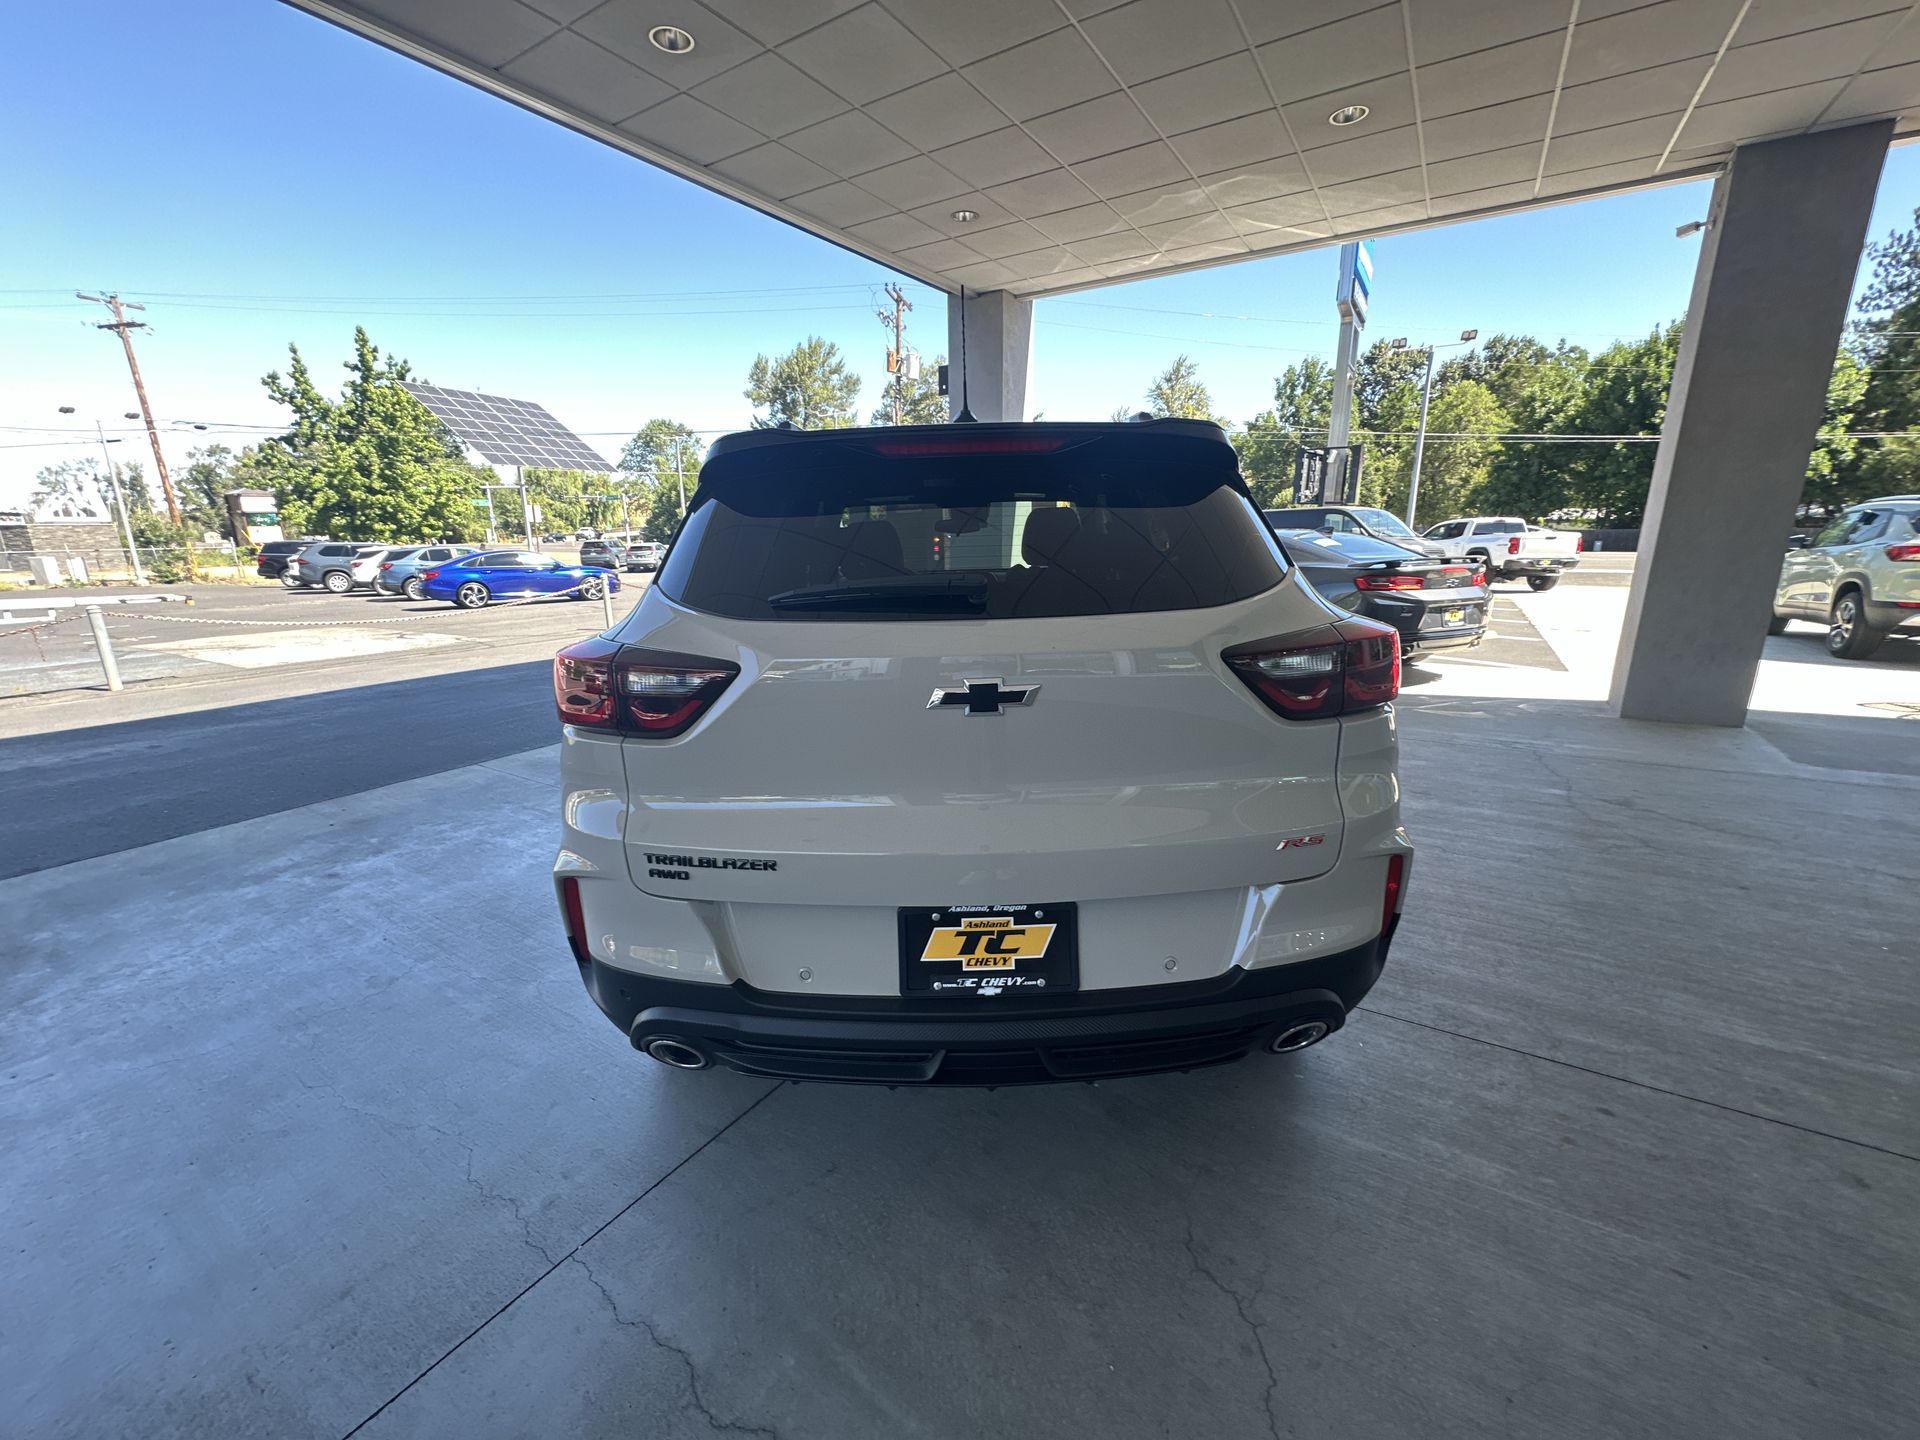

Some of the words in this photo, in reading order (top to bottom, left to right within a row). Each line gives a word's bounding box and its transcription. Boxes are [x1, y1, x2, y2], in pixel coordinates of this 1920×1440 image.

[1276, 834, 1325, 851] RS
[642, 852, 778, 872] TRAILBLAZER
[648, 868, 690, 881] AWD
[948, 905, 990, 913] Ashland,
[993, 904, 1028, 912] Oregon
[964, 920, 1010, 929] Ashland
[953, 929, 1026, 956] TC
[965, 956, 1012, 967] CHEVY
